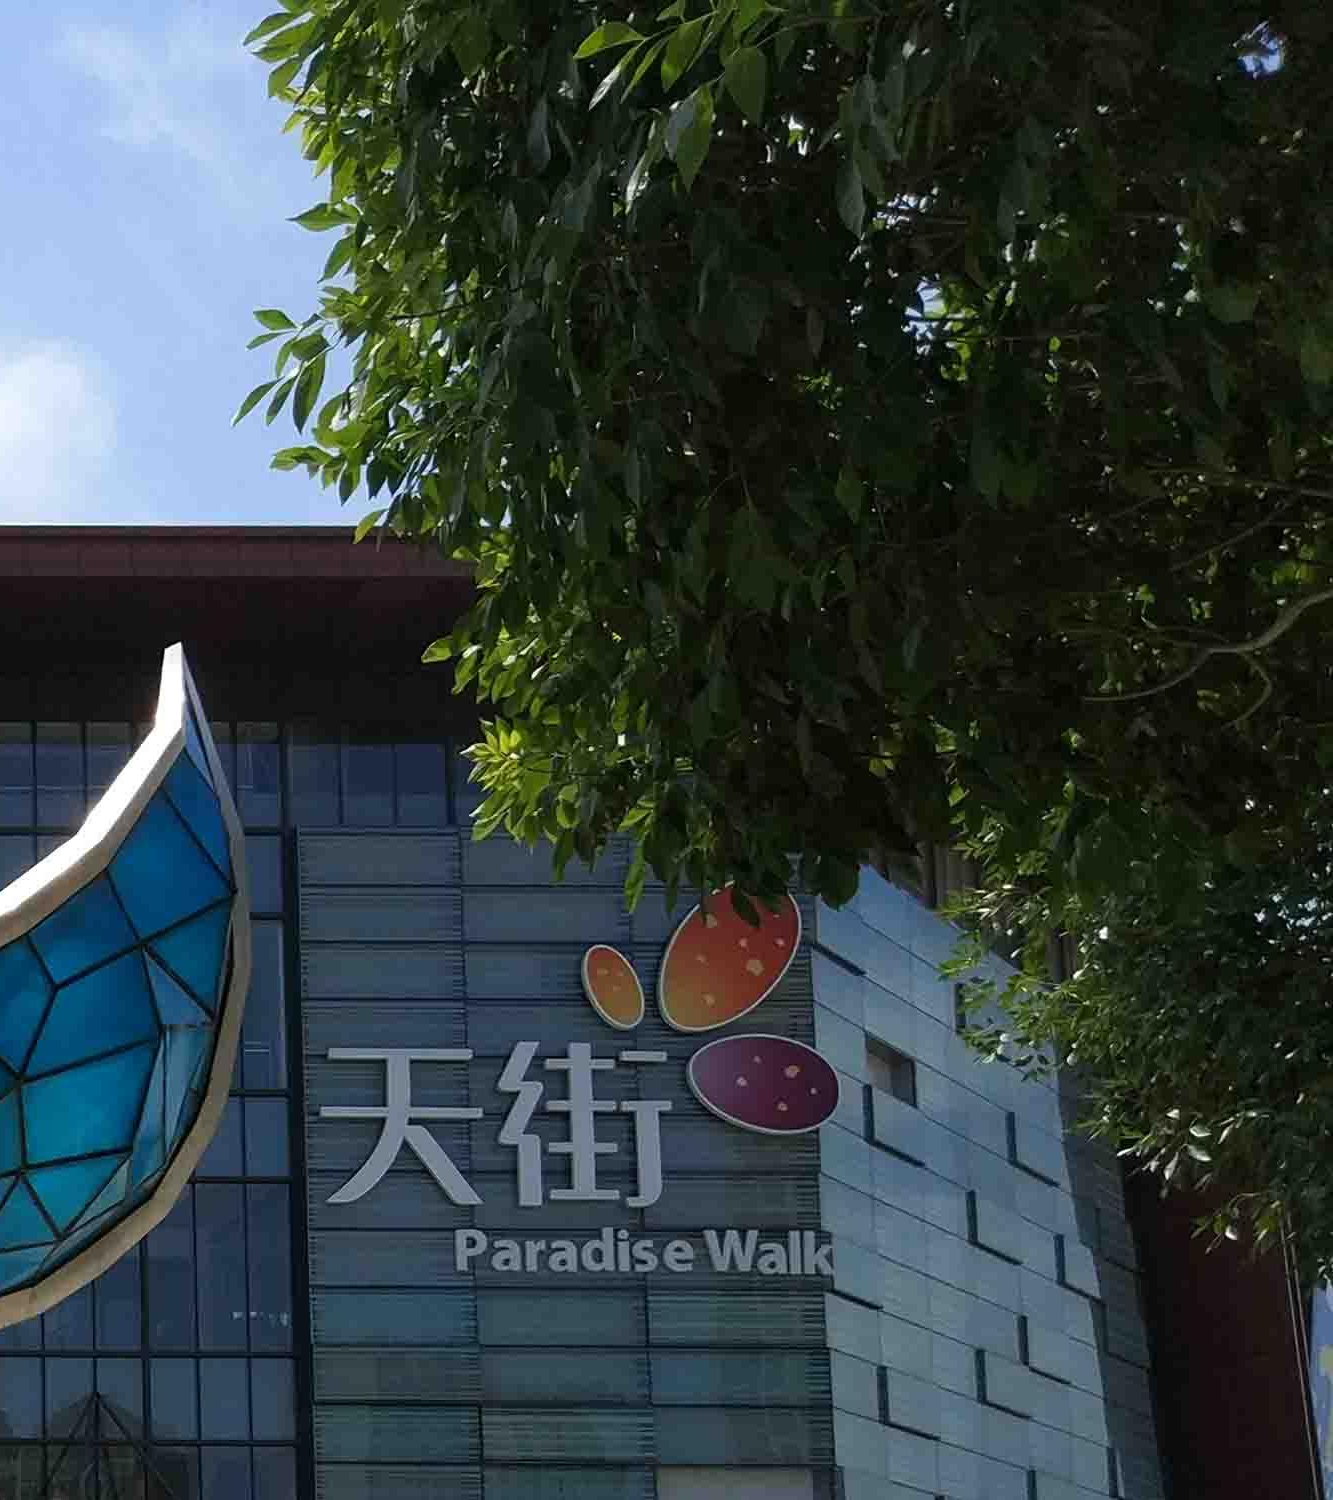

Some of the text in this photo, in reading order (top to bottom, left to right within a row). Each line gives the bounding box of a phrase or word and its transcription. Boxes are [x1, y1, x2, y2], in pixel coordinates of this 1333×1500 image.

[319, 1040, 673, 1207] 天街
[453, 1227, 835, 1275] Paradise Walk
